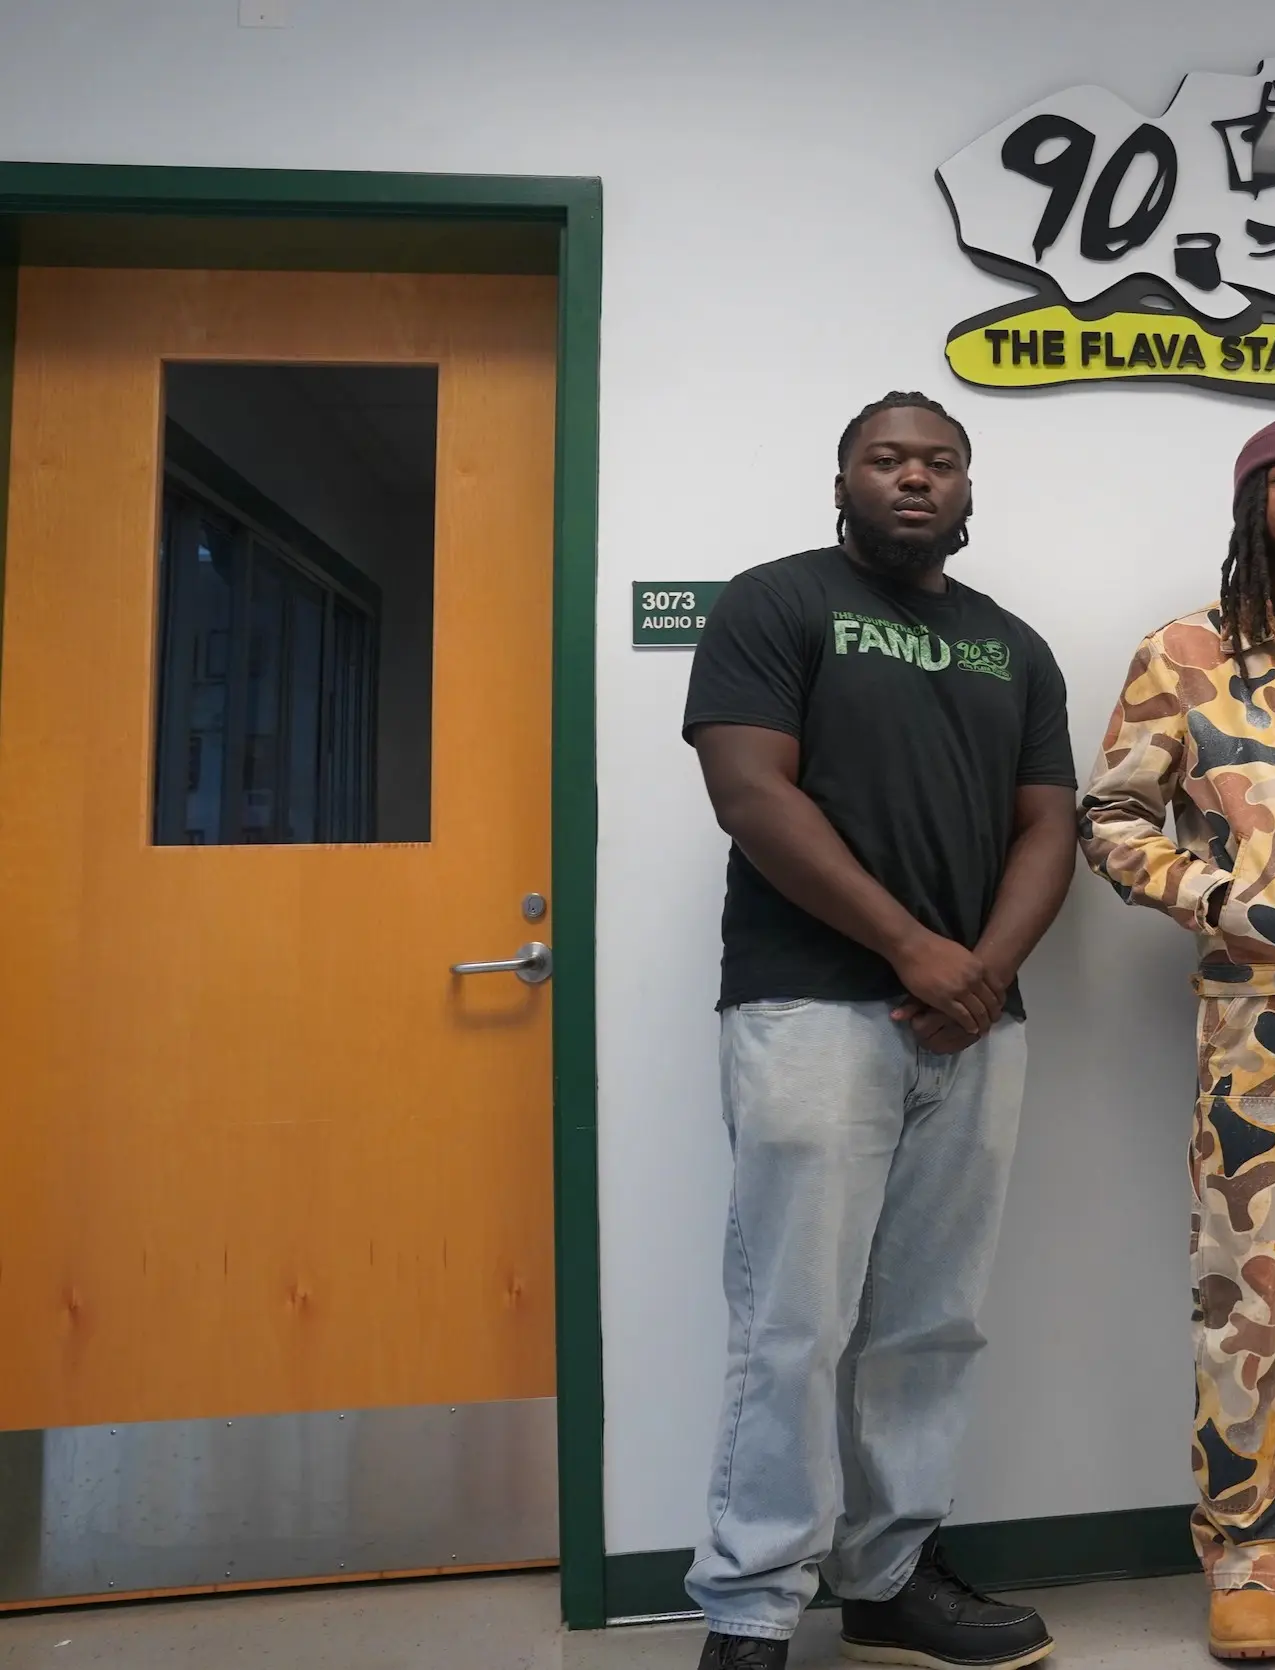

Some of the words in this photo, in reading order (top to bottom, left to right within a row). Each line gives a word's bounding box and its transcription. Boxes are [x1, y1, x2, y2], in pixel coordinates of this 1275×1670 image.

[984, 329, 1066, 367] THE
[1081, 332, 1206, 370] FLAVA
[641, 591, 696, 610] 3073
[641, 615, 692, 629] AUDIO
[695, 615, 706, 629] B
[832, 611, 854, 621] THE
[856, 614, 930, 636] SOUNDTRACK
[833, 619, 951, 672] FAMU
